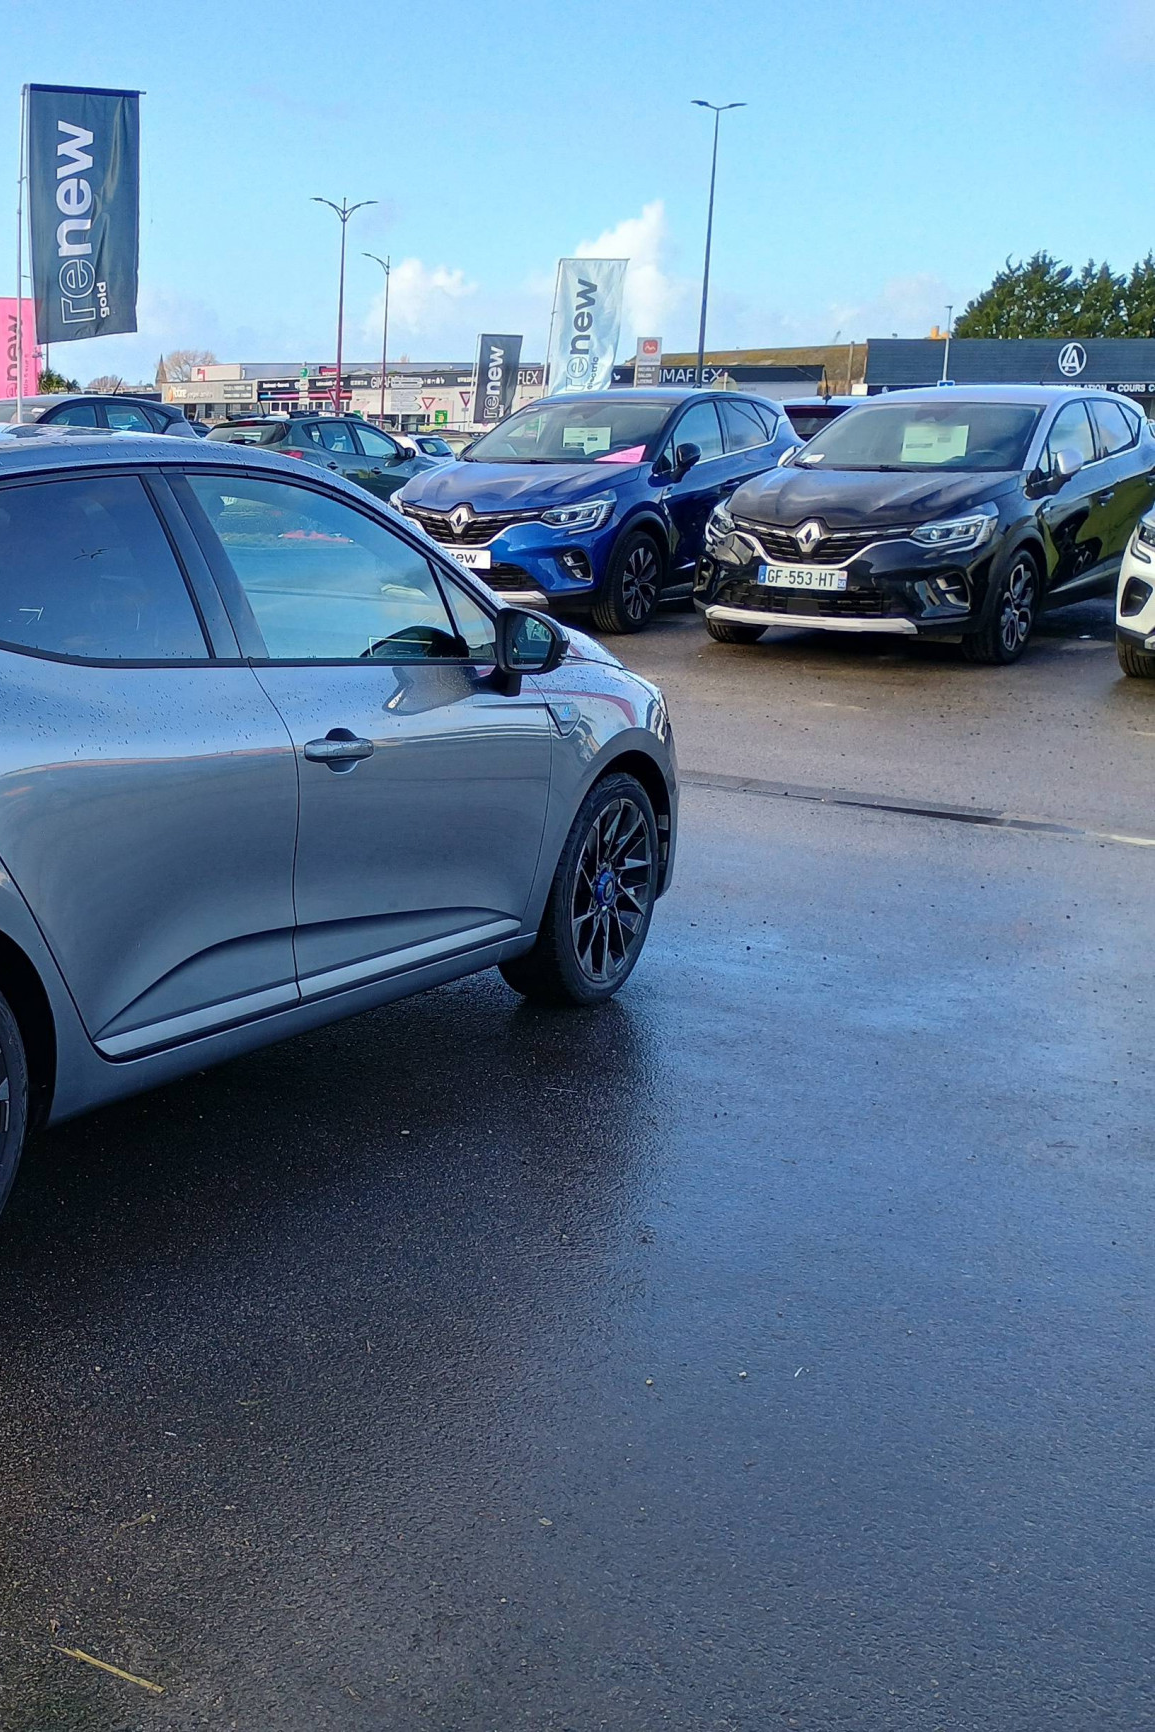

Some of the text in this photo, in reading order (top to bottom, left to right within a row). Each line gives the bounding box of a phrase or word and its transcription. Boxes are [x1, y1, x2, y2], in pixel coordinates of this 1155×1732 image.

[56, 120, 96, 324] renew
[97, 281, 110, 318] gold
[565, 278, 598, 391] renew
[483, 346, 505, 418] renew
[1117, 383, 1146, 393] COURS
[767, 569, 836, 588] GF-553-HT
